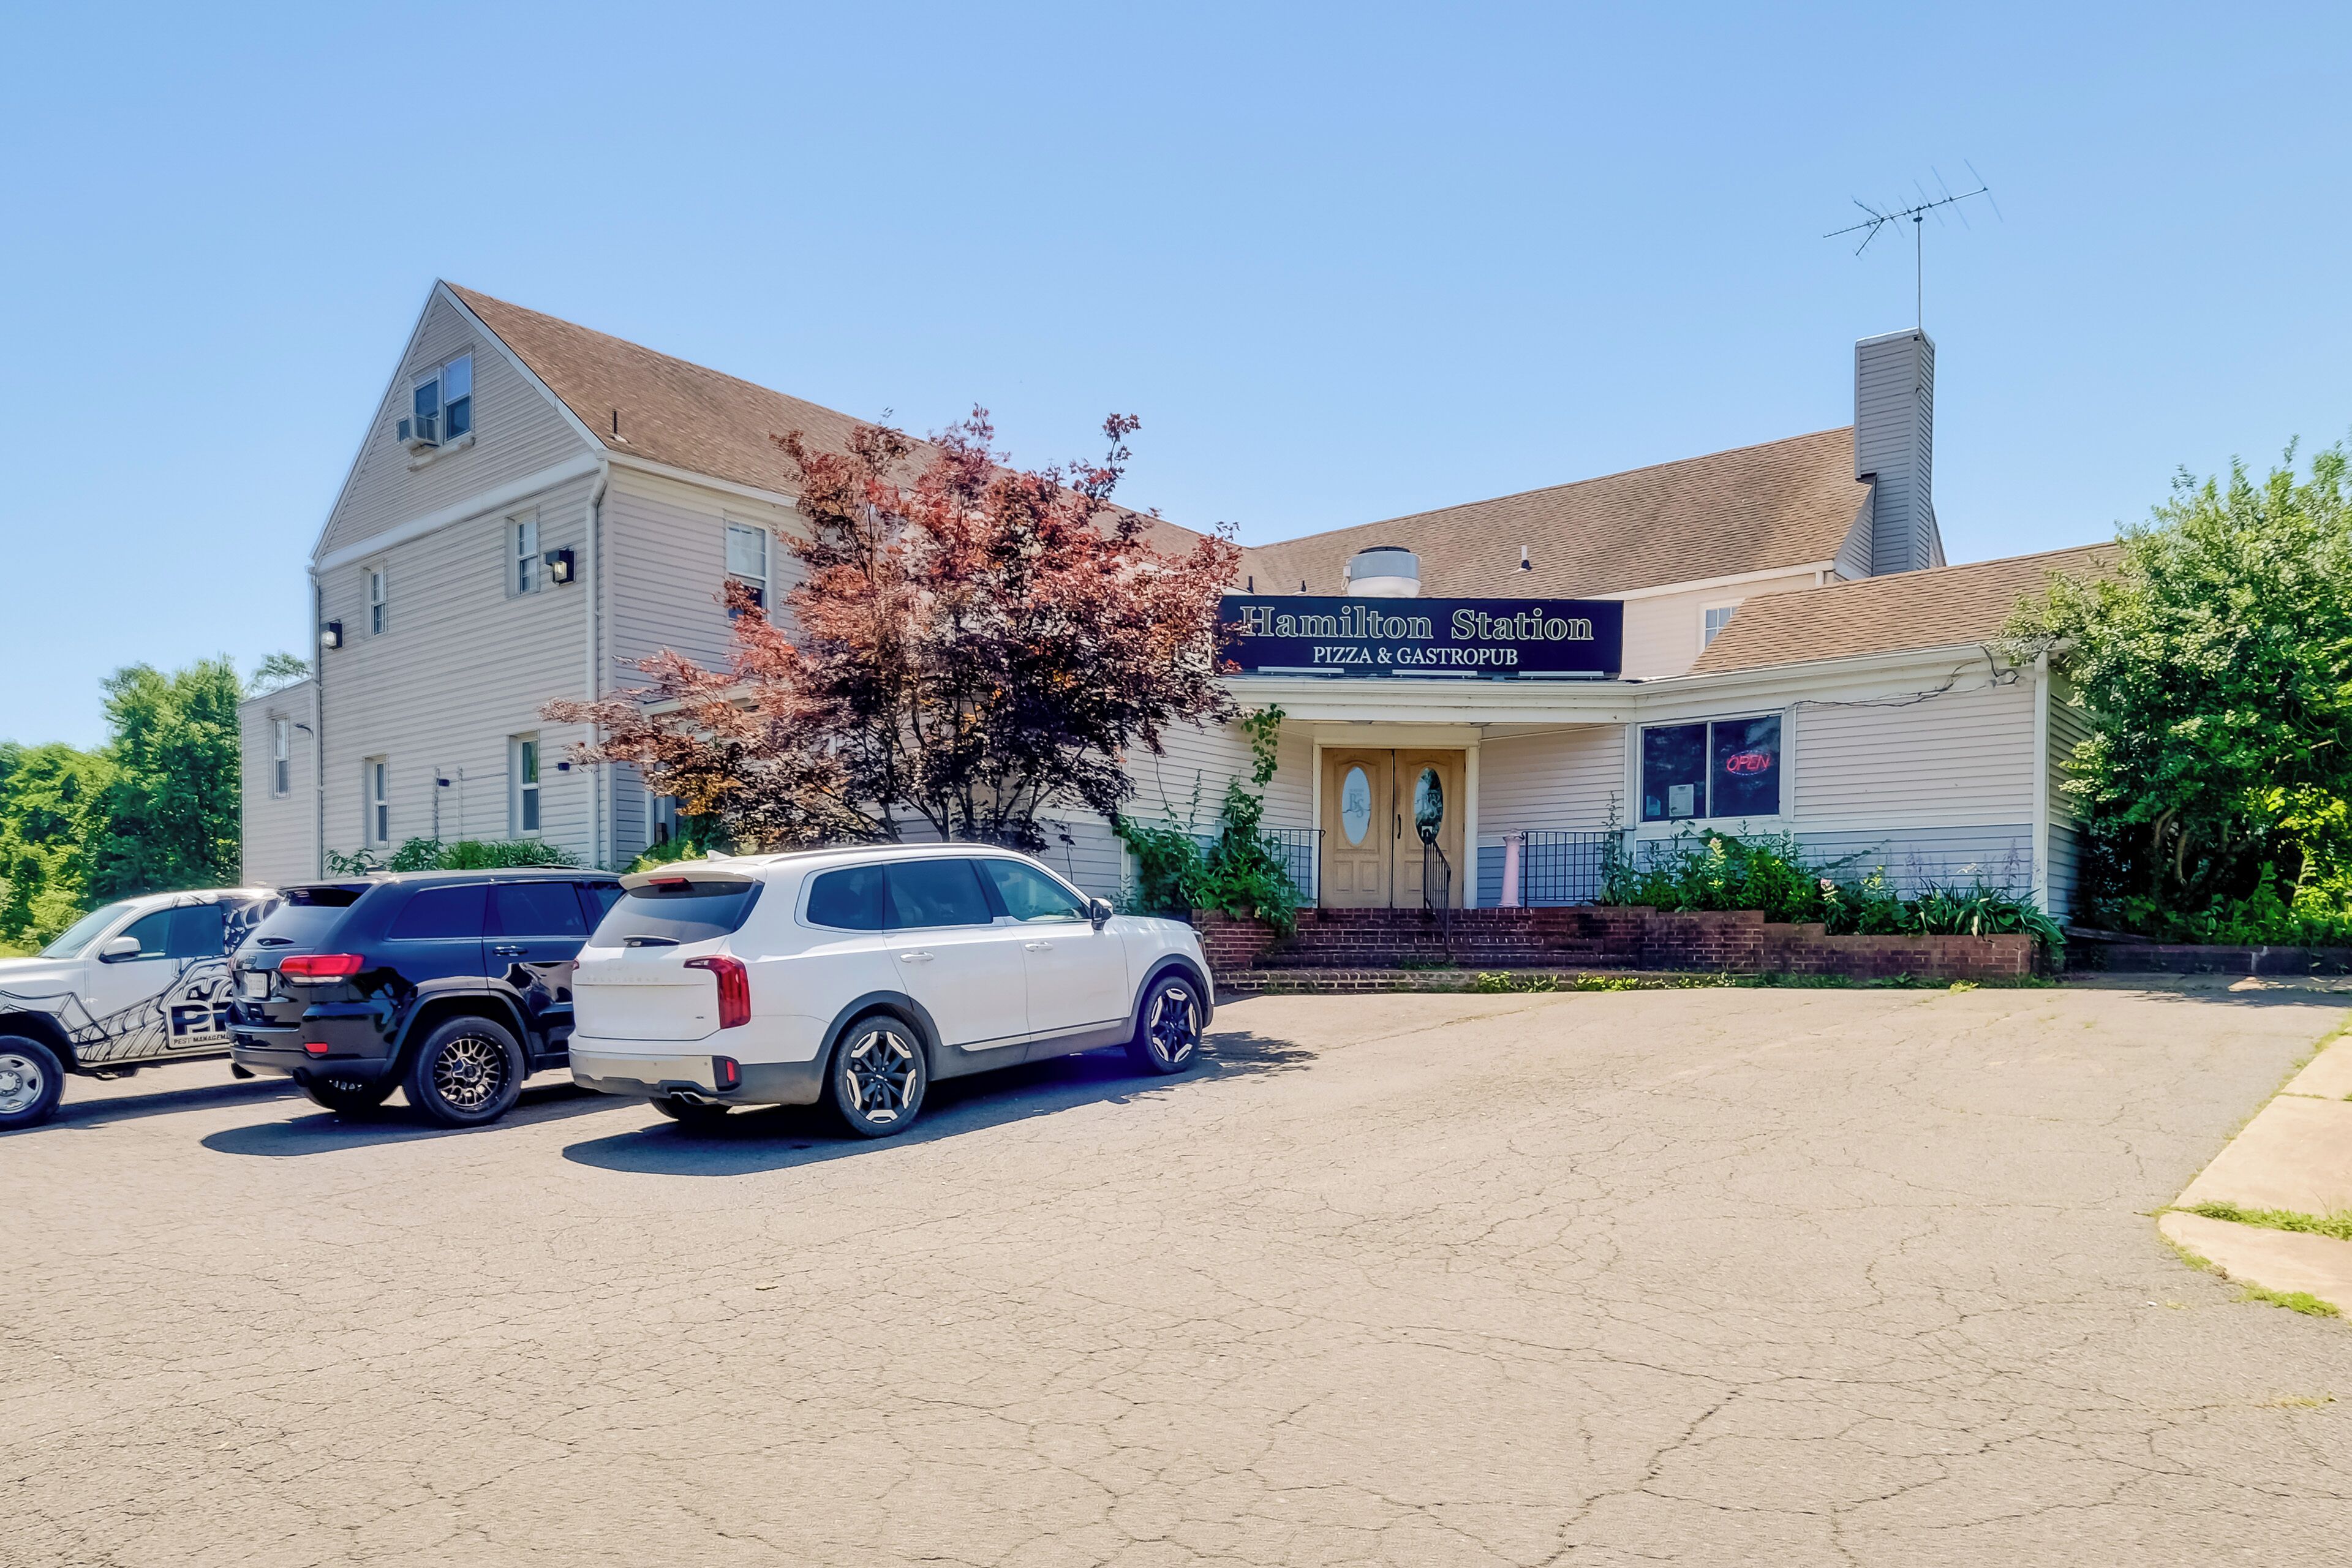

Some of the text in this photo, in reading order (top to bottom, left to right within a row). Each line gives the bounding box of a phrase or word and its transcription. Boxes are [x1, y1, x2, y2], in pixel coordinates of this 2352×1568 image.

[1240, 605, 1594, 640] Hamilton Station
[1313, 646, 1518, 665] PIZZA & GASTROPUB
[1727, 755, 1770, 772] OPEN
